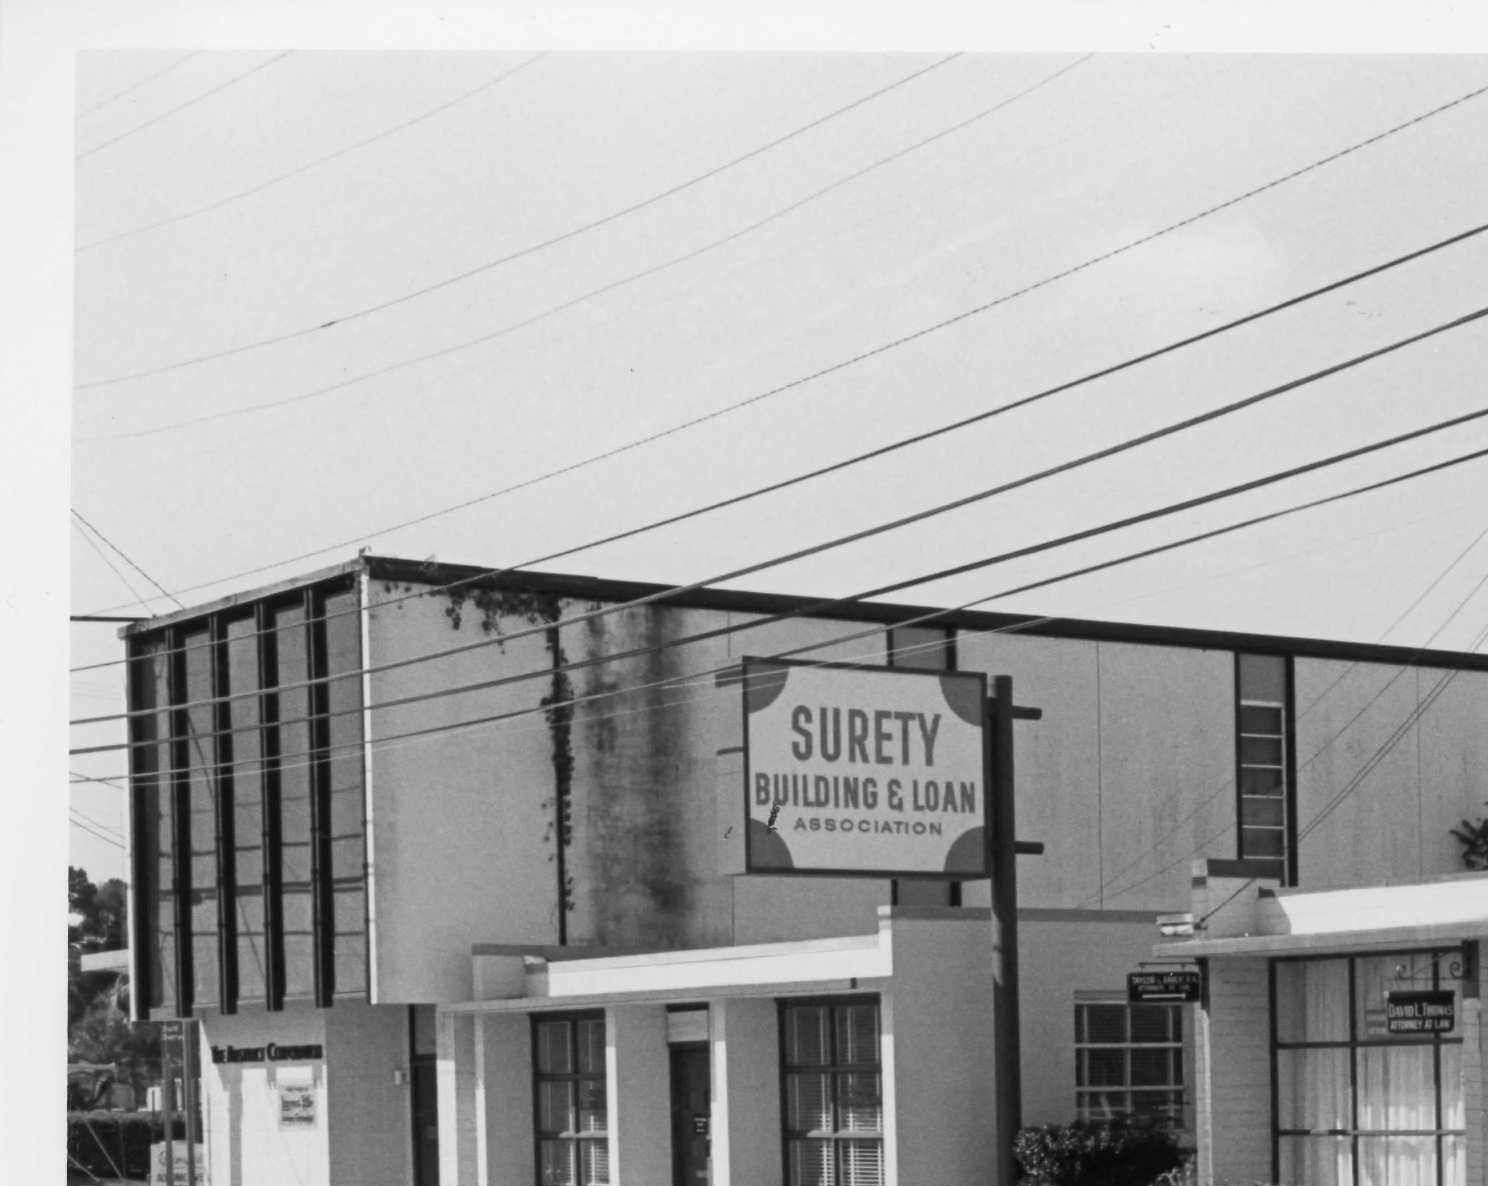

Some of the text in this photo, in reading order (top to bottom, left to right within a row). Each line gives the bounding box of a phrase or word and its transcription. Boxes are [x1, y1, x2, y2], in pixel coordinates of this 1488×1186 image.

[791, 704, 942, 767] SURETY
[755, 772, 976, 814] BUILDING & LOAN
[793, 816, 943, 836] ASSOCIATION
